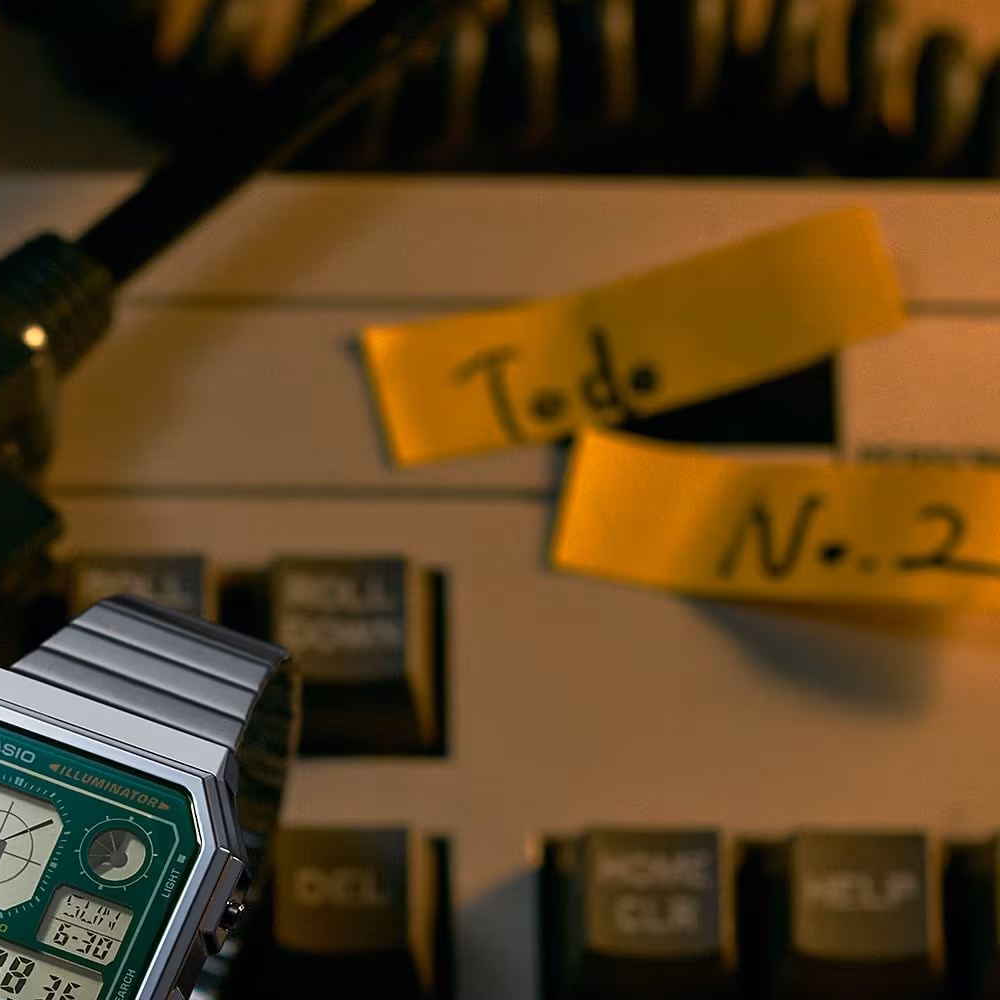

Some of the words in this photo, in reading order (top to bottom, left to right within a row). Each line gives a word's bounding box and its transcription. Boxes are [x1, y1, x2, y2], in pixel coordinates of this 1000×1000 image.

[892, 504, 1000, 576] 2
[59, 765, 159, 808] ILLUMINATOR
[161, 868, 181, 898] LIGHT
[53, 924, 113, 960] 6-30
